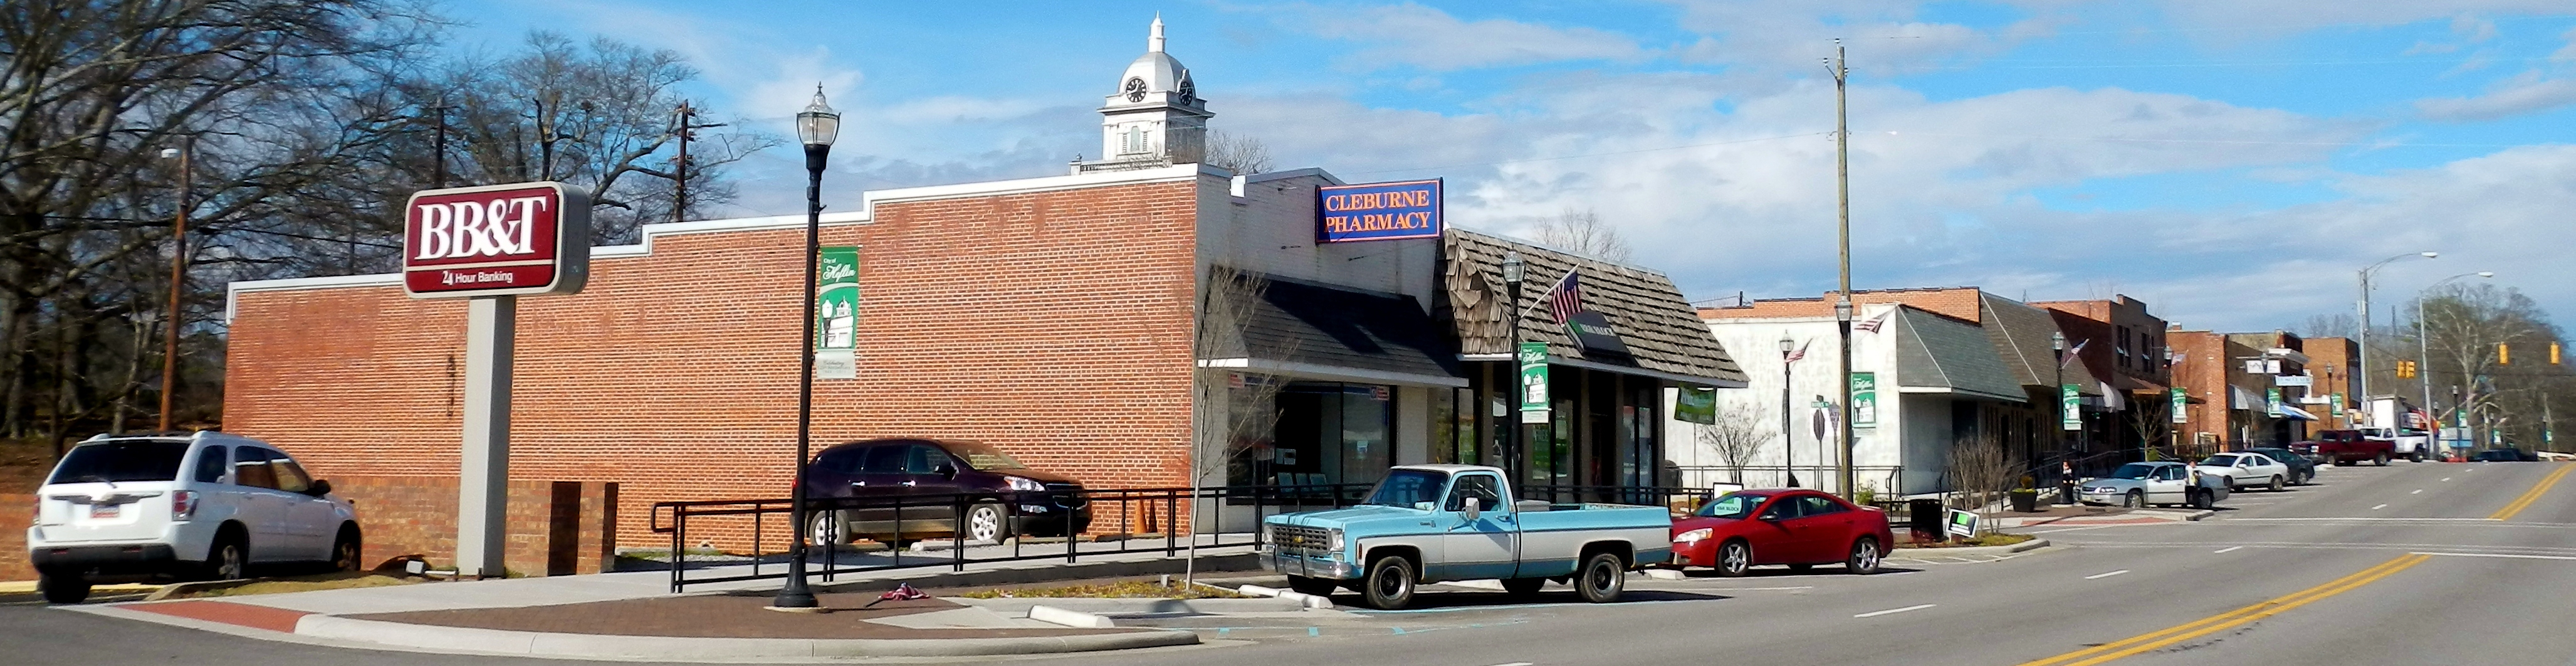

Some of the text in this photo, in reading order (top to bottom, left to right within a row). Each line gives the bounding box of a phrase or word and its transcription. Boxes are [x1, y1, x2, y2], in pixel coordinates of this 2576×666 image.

[1325, 189, 1430, 212] CLEBURNE
[414, 196, 547, 260] BB&T
[1324, 211, 1432, 233] PHARMACY
[442, 270, 513, 285] 24 Hour Banking
[822, 263, 856, 282] Heflin
